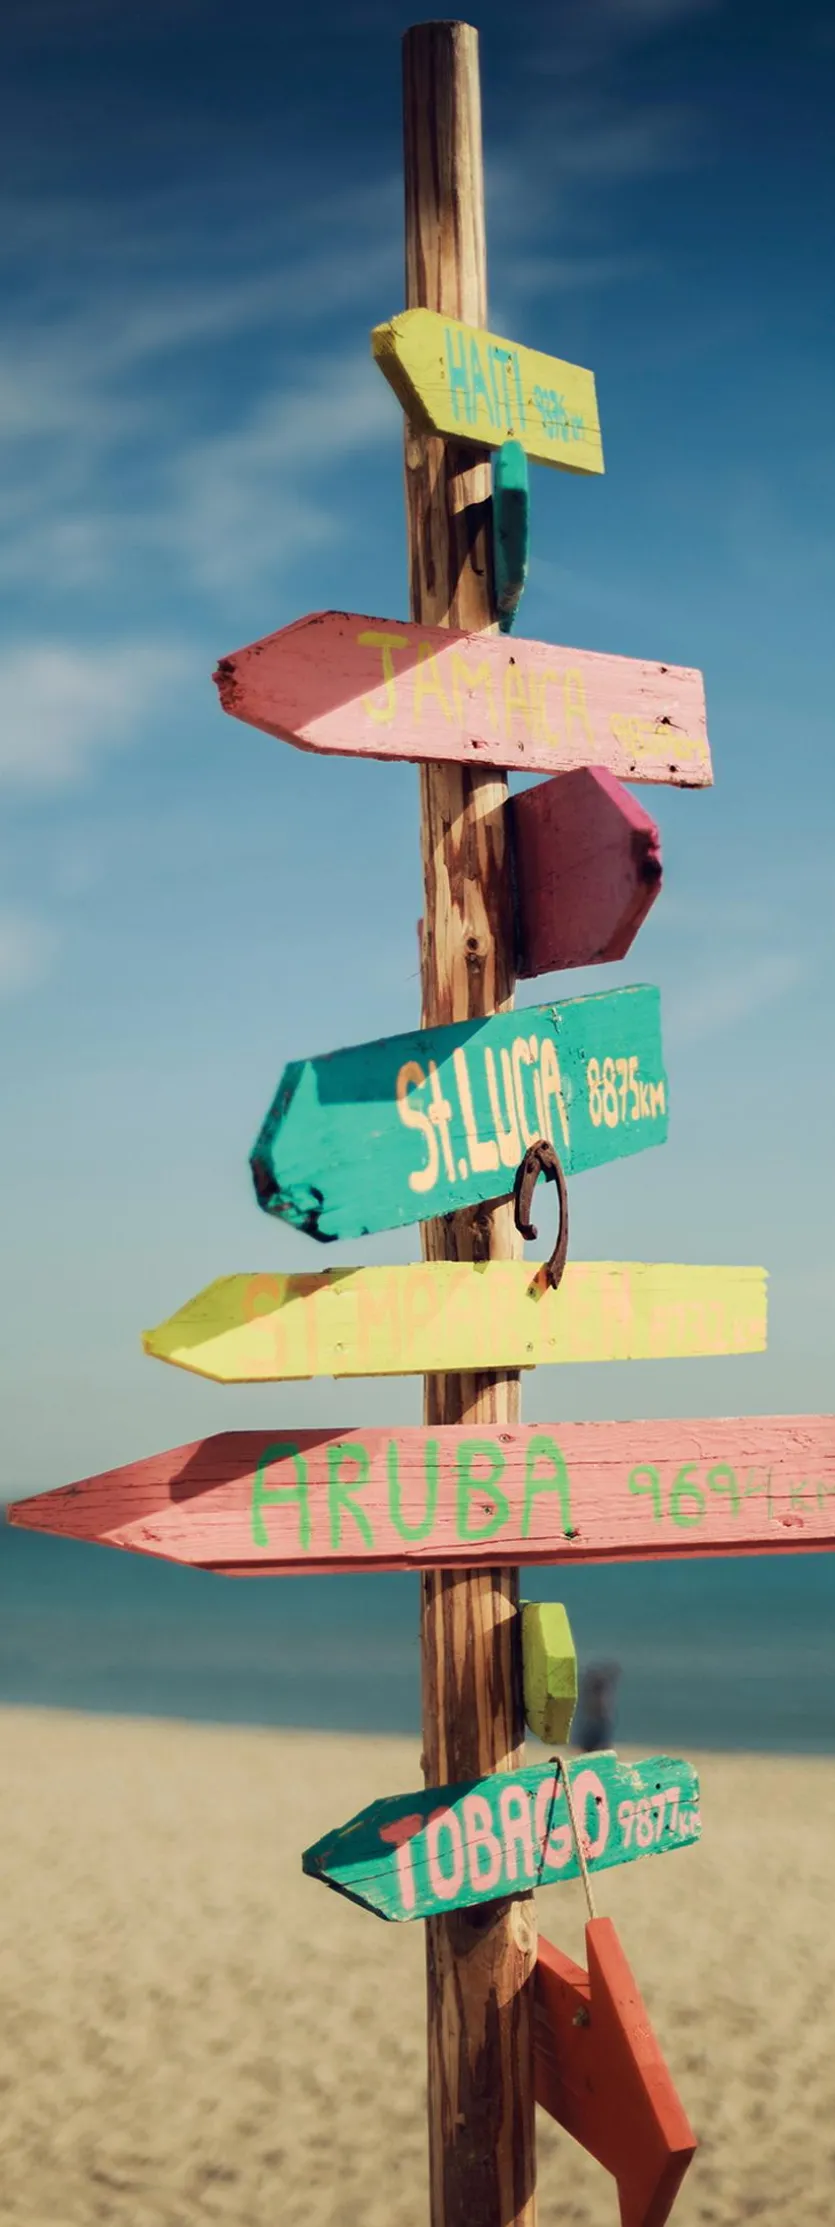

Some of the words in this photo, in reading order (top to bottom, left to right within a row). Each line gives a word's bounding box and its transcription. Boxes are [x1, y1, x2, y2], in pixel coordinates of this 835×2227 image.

[445, 327, 525, 431] HAITI
[357, 631, 594, 746] JAMAICA
[251, 1435, 574, 1549] ARUBA
[628, 1462, 773, 1528] 9694
[379, 1770, 610, 1910] TOBAGO
